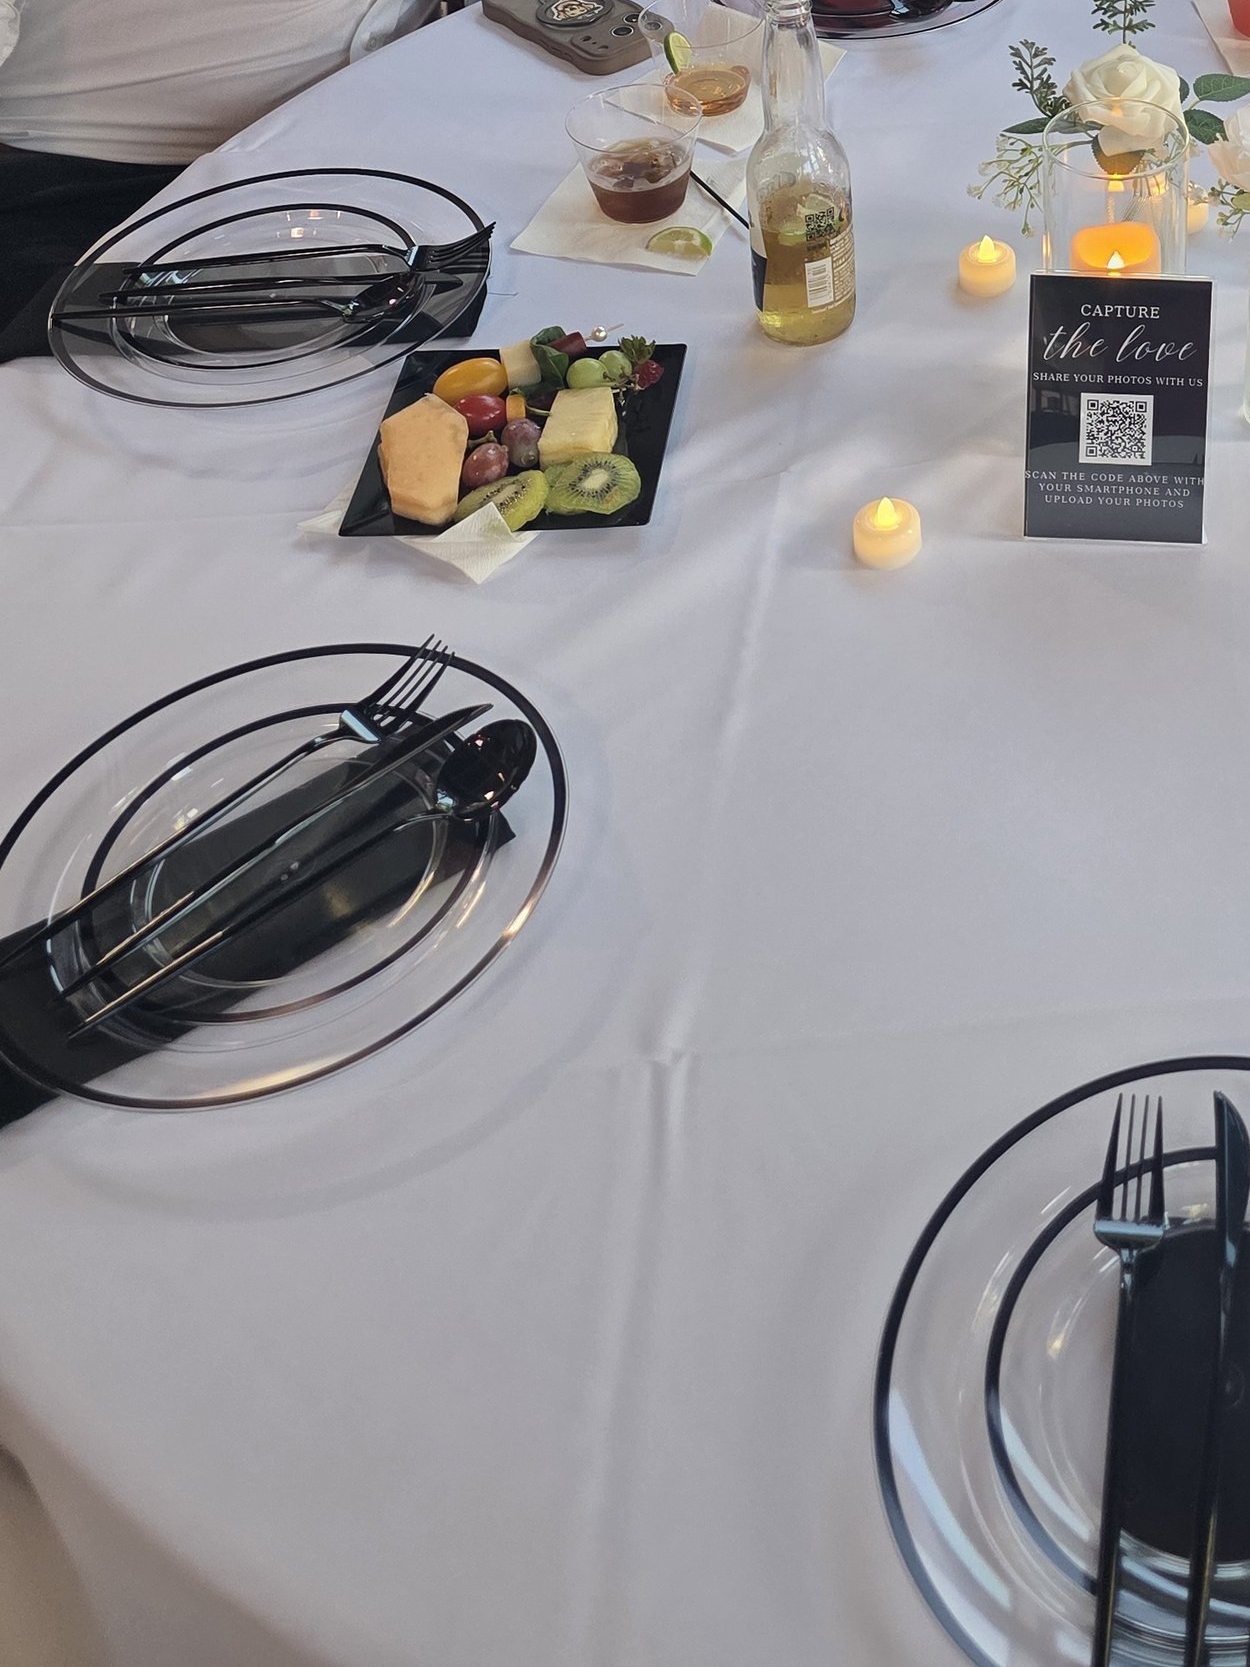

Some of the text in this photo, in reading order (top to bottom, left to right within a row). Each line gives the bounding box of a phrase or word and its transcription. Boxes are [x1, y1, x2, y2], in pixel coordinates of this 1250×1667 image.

[1080, 304, 1160, 319] CAPTURE
[1043, 321, 1198, 363] the love
[1033, 372, 1203, 387] SHARE YOUR PHOTOS WITH US
[1025, 470, 1205, 485] SCAN THE CODE ABOVE WITH
[1038, 483, 1190, 497] YOUR SMARTPHONE AND
[1044, 494, 1184, 508] UPLOAD YOUR PHOTOS
